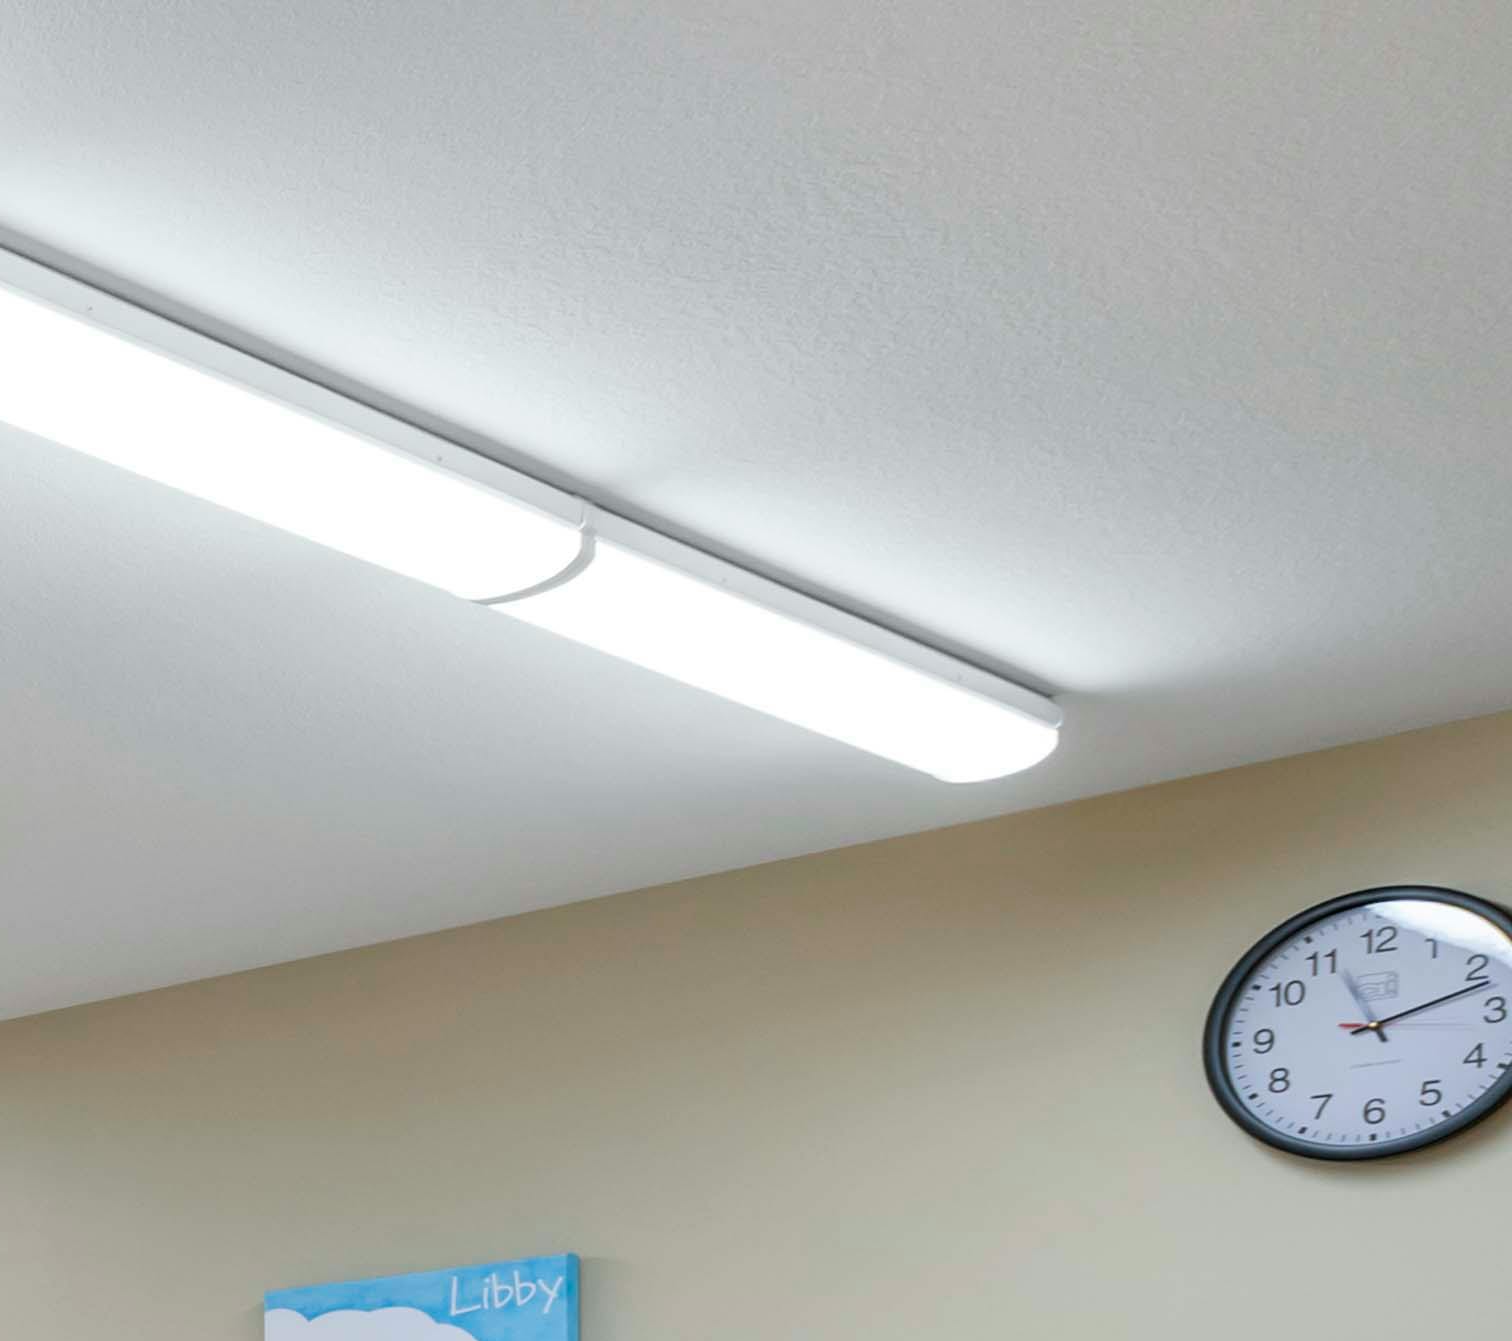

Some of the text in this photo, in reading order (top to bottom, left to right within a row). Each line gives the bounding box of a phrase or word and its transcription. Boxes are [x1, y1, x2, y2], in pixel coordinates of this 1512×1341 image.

[1360, 926, 1398, 954] 12
[1425, 937, 1439, 959] 1
[1306, 949, 1338, 977] 11
[1465, 954, 1490, 982] 2
[1269, 980, 1306, 1008] 10
[1483, 996, 1507, 1024] 3
[1253, 1028, 1275, 1054] 9
[1463, 1042, 1487, 1069] 4
[1268, 1067, 1291, 1093] 8
[1419, 1079, 1443, 1106] 5
[1310, 1094, 1333, 1120] 7
[1363, 1098, 1386, 1124] 6
[450, 1269, 564, 1316] Libby
